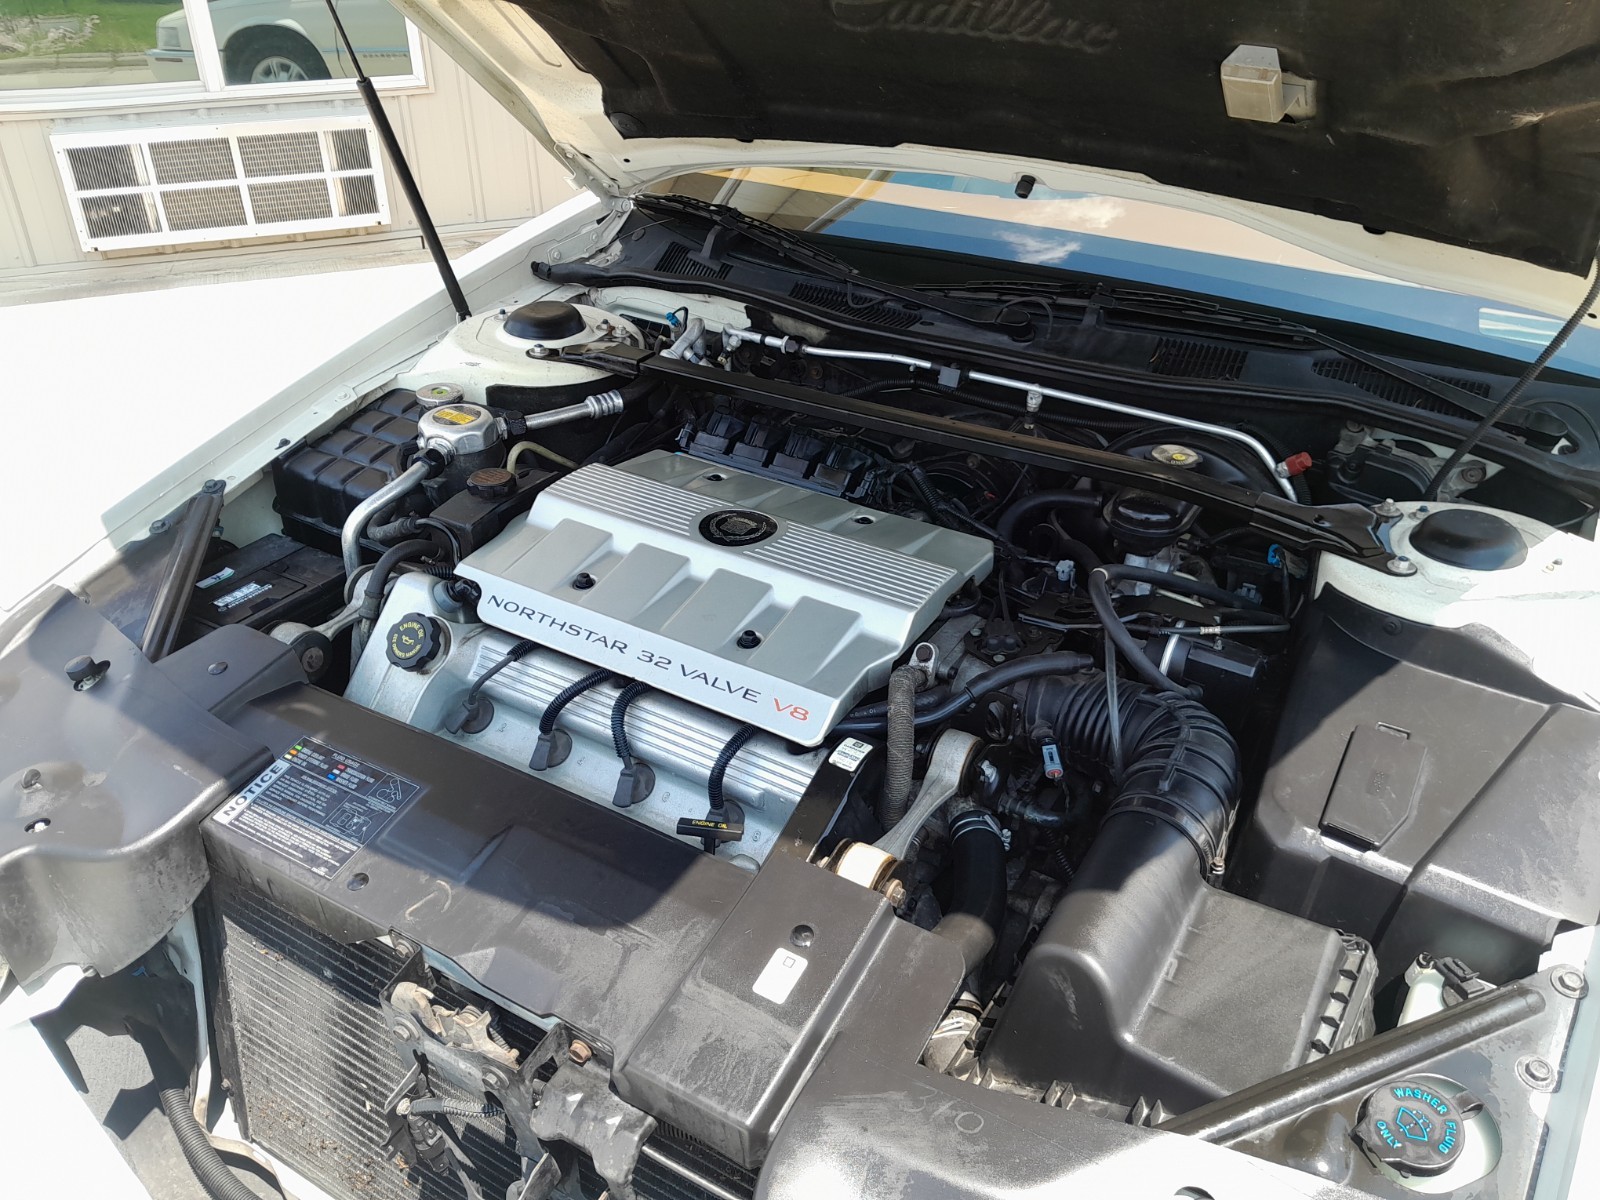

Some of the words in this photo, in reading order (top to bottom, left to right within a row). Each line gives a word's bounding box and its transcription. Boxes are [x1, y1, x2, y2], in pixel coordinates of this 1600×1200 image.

[399, 621, 420, 631] ENGINE
[487, 595, 629, 655] NORTHSTAR
[636, 650, 672, 671] 32
[680, 664, 762, 704] VALVE
[772, 698, 811, 722] V8
[222, 764, 284, 817] NOTICE
[692, 820, 715, 828] ENGINE
[1376, 1121, 1403, 1149] ONLY
[1394, 1087, 1448, 1115] WASHER
[1438, 1120, 1457, 1154] FLUID
